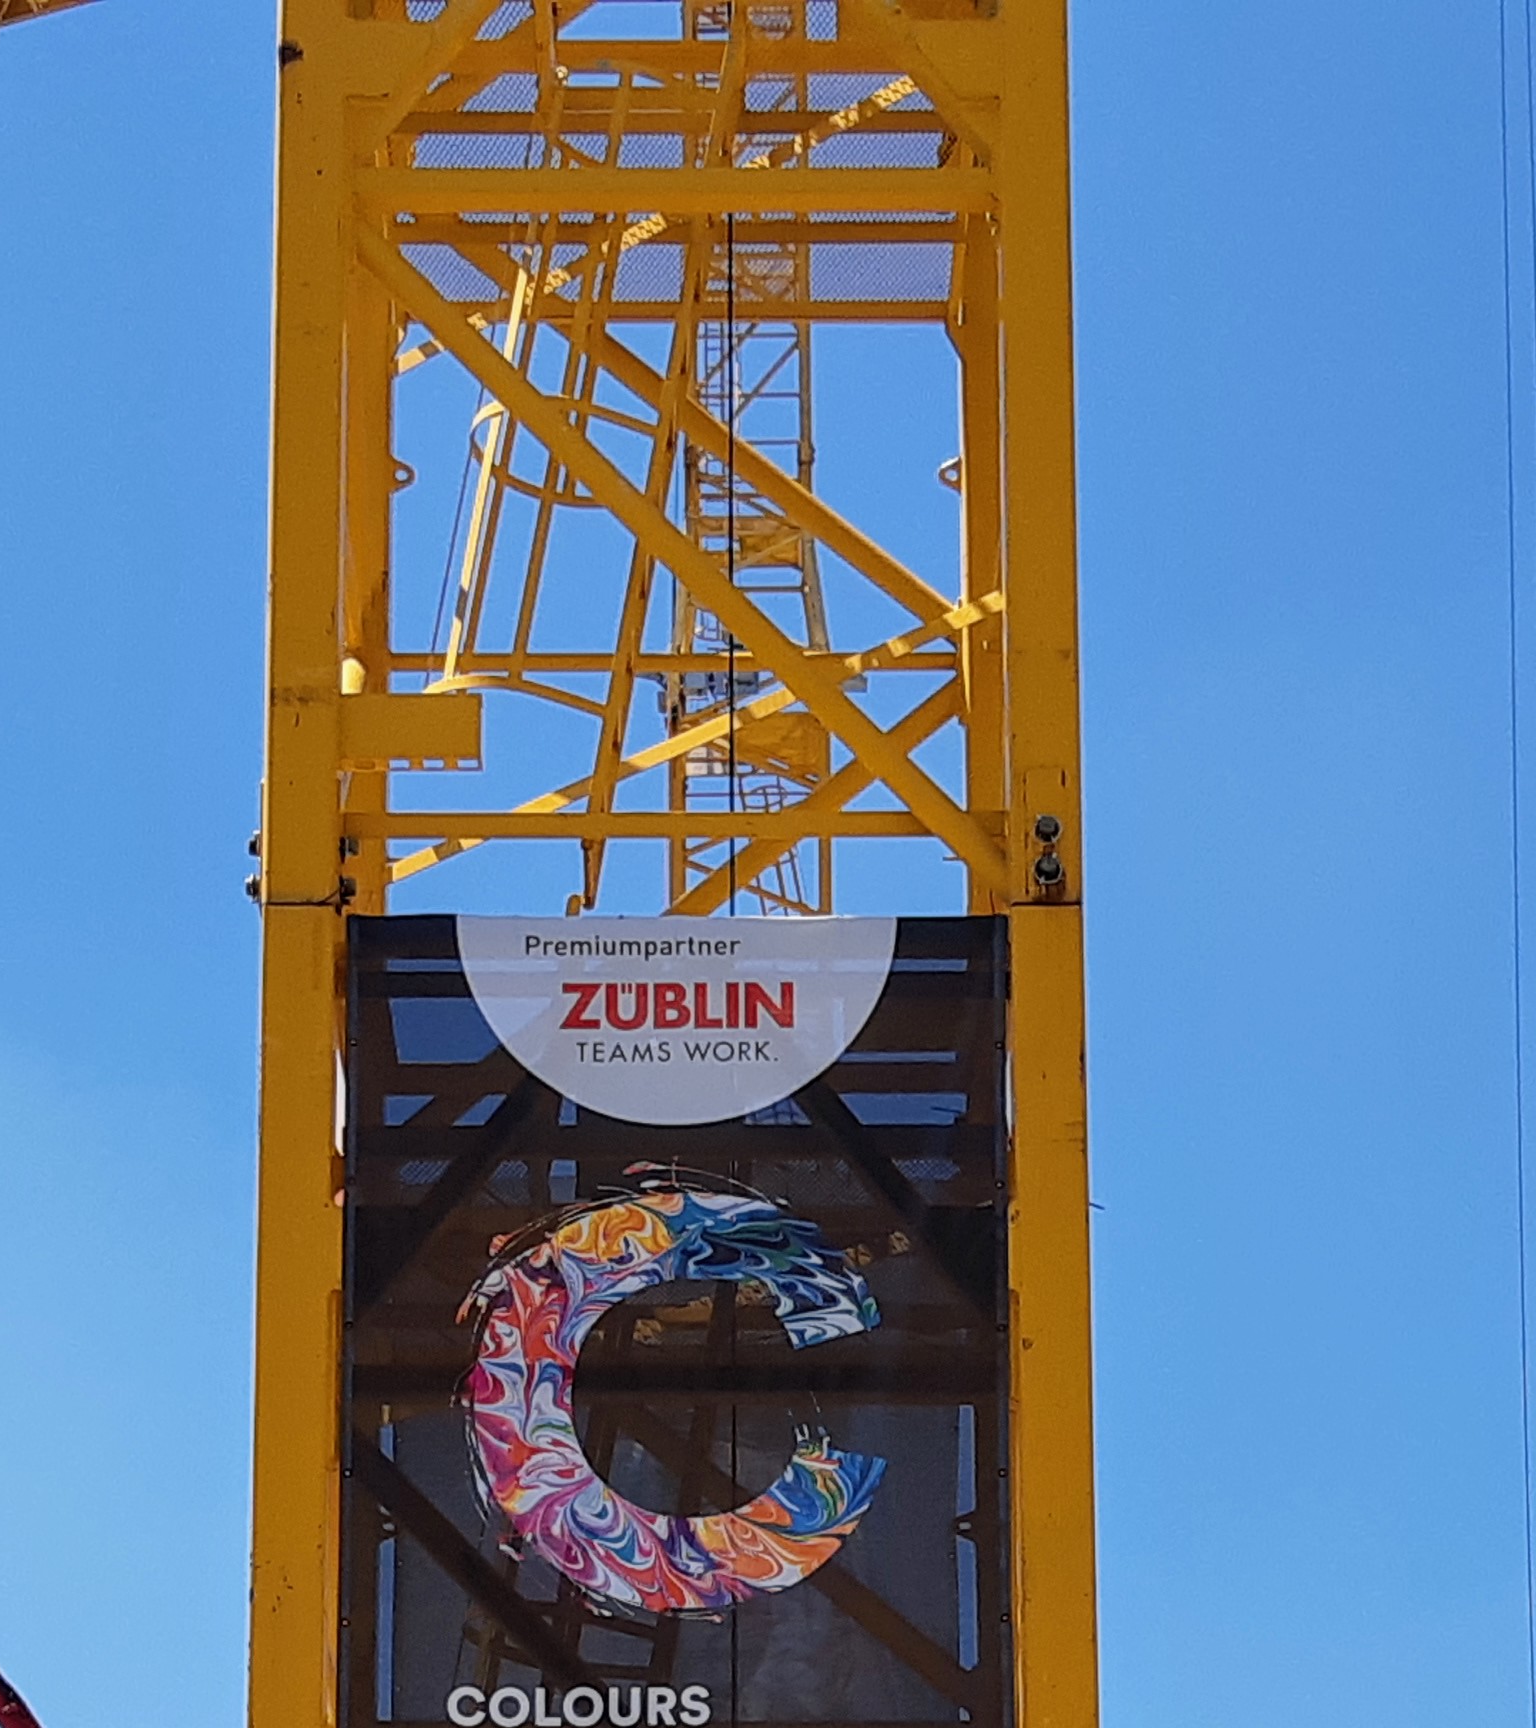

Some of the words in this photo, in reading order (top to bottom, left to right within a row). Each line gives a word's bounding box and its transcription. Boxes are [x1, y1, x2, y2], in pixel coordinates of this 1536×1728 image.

[525, 935, 741, 961] Premiumpartner
[560, 981, 795, 1030] ZÜBLIN
[577, 1041, 672, 1063] TEAMS
[684, 1040, 779, 1062] WORK.
[446, 1685, 712, 1728] COLOURS
